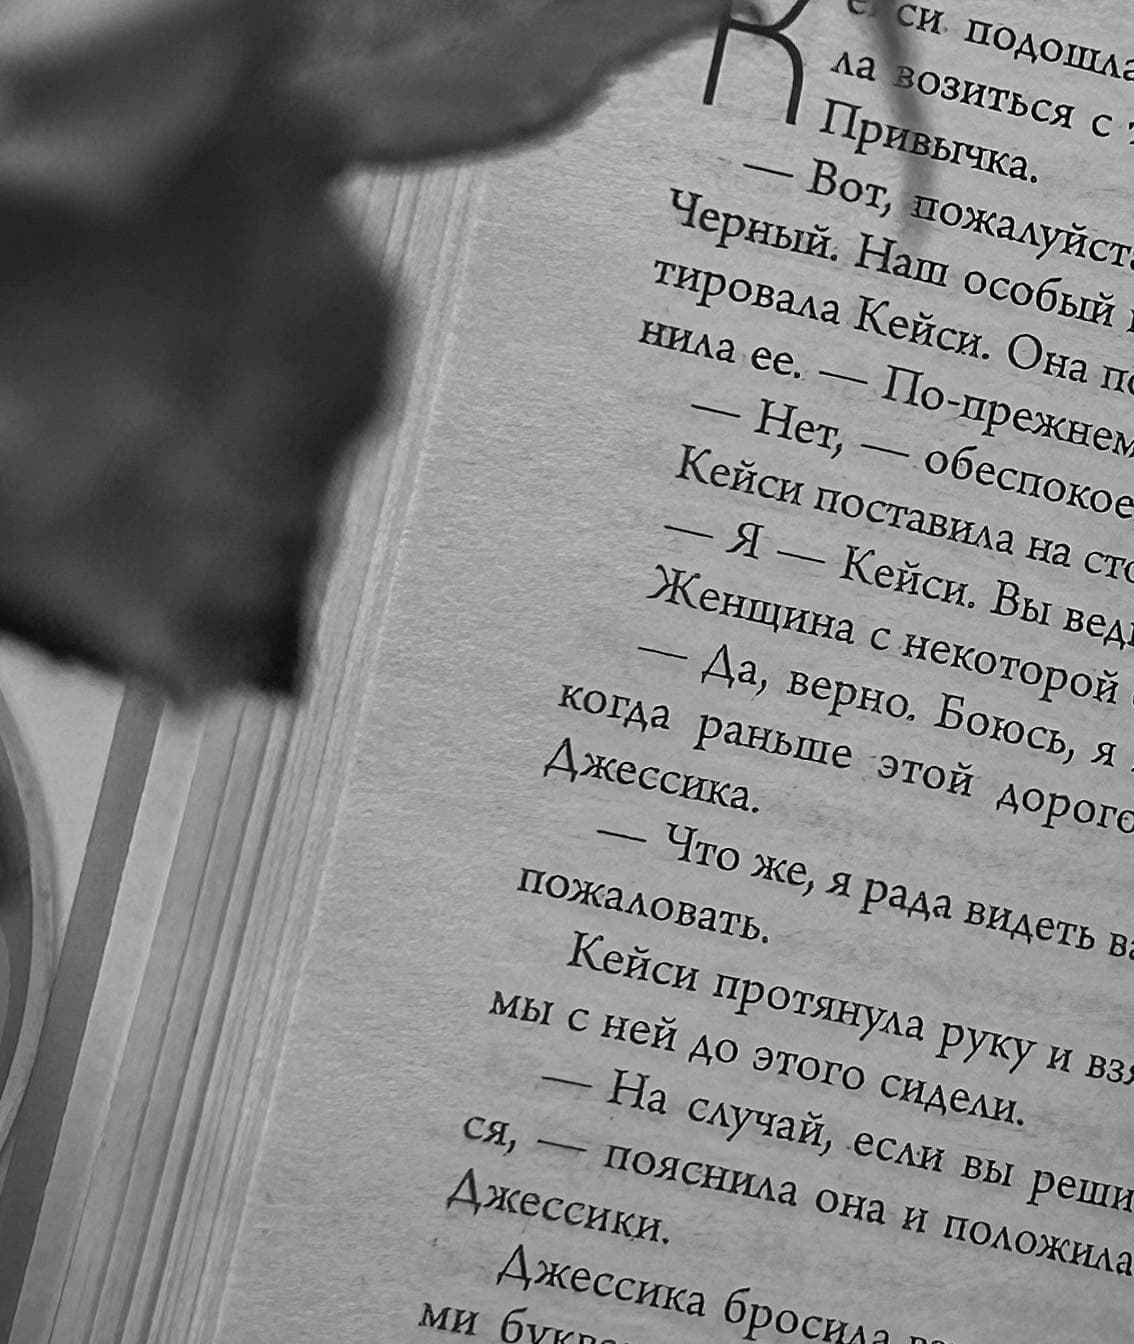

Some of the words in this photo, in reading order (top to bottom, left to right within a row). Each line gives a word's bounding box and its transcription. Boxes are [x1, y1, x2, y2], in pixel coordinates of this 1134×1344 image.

[818, 97, 1038, 184] Привычка.
[891, 63, 1076, 130] возиться
[805, 157, 892, 219] Вот,
[669, 187, 838, 262] Черный.
[853, 231, 950, 288] Наш
[964, 270, 1116, 328] особый
[637, 319, 737, 364] нила
[750, 346, 801, 379] ее.
[653, 259, 841, 326] тировала
[853, 294, 990, 361] Кейси.
[1007, 333, 1088, 384] Она
[753, 397, 843, 460] Нет,
[674, 443, 805, 507] Кейси
[812, 486, 1014, 556] поставила
[645, 563, 855, 645] Женщина
[901, 633, 1120, 705] некоторой
[839, 543, 976, 609] Кейси.
[989, 579, 1053, 627] Вы
[557, 684, 671, 733] когда
[692, 714, 853, 769] раньше
[877, 754, 975, 798] этой
[700, 643, 768, 697] Да,
[785, 670, 916, 722] верно.
[932, 692, 1075, 765] Боюсь,
[542, 736, 760, 814] Джессика.
[516, 867, 769, 945] пожаловать.
[665, 822, 740, 872] Что
[750, 853, 815, 898] же,
[858, 878, 953, 923] рада
[962, 900, 1096, 951] видеть
[566, 930, 701, 992] Кейси
[712, 973, 924, 1042] протянула
[934, 1022, 1038, 1075] руку
[488, 990, 555, 1026] мы
[599, 1014, 678, 1053] ней
[687, 1034, 739, 1067] до
[752, 1046, 865, 1091] этого
[880, 1074, 1025, 1127] сидели.
[605, 1068, 667, 1116] На
[687, 1097, 832, 1158] случай,
[853, 1132, 946, 1173] если
[959, 1154, 1015, 1188] вы
[446, 1167, 670, 1246] Джессики.
[463, 1116, 517, 1157] ся,
[602, 1144, 798, 1208] пояснила
[815, 1188, 886, 1226] она
[942, 1214, 1133, 1277] положила
[417, 1302, 480, 1337] ми
[495, 1243, 706, 1318] Джессика
